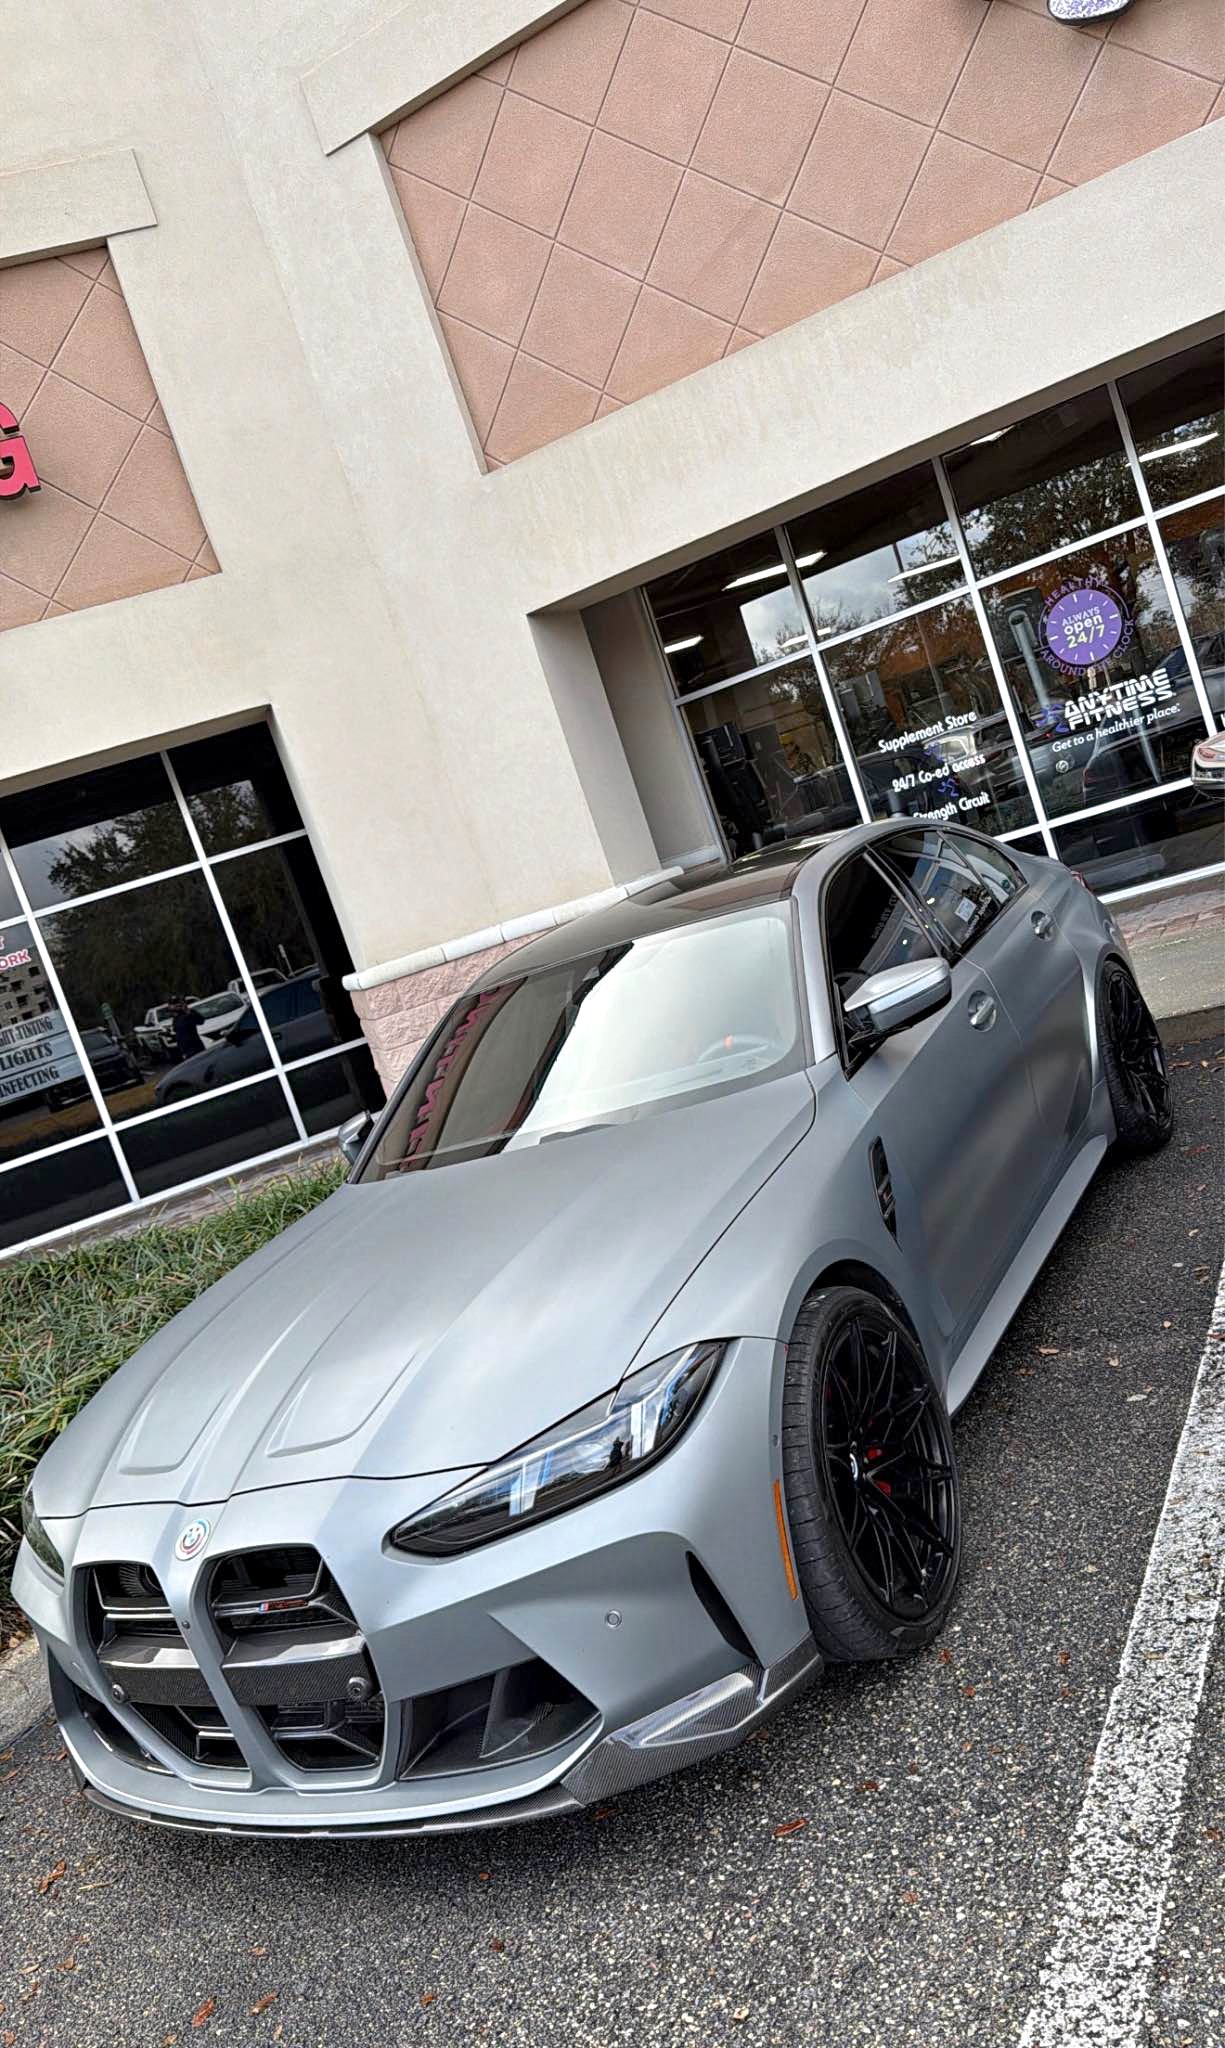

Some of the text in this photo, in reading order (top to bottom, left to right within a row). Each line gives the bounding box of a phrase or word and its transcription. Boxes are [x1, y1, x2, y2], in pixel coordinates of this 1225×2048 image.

[1062, 606, 1101, 627] ALWAYS
[1063, 614, 1103, 635] open
[1040, 649, 1087, 677] AROUND
[1113, 618, 1134, 659] CLOCK
[1066, 624, 1105, 649] 24/7
[1064, 667, 1171, 718] ANYTIME
[1068, 684, 1174, 731] FITNESS
[878, 711, 977, 753] Supplement Store
[1052, 740, 1072, 753] Get
[1074, 734, 1085, 746] to
[1086, 733, 1094, 742] a
[1095, 716, 1144, 738] healthier
[892, 754, 986, 793] 24/7 Co-ed access
[958, 791, 991, 811] Circuit
